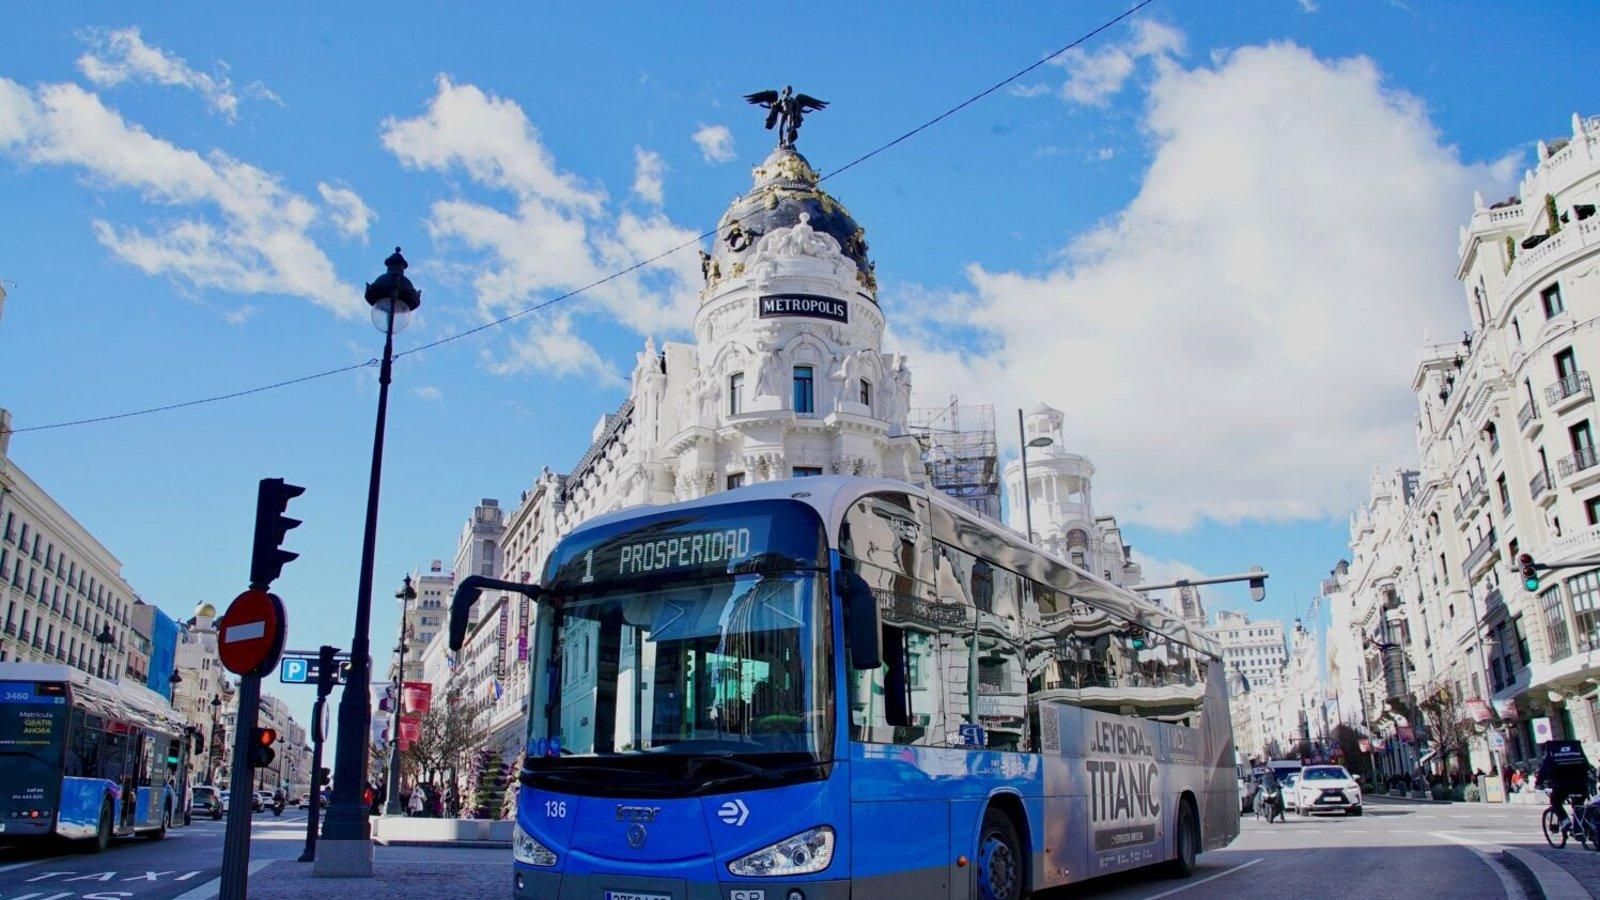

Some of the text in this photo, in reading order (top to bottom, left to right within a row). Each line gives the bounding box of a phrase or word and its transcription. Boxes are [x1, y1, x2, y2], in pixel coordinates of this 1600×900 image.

[763, 299, 844, 317] METROPOLIS
[581, 528, 751, 582] 1 PROSPERIDAD
[288, 662, 302, 679] P
[4, 692, 29, 700] 3460
[1095, 720, 1147, 755] LEYENDA
[1086, 760, 1160, 822] TITANIC
[544, 800, 567, 818] 136
[24, 871, 204, 882] TAXI
